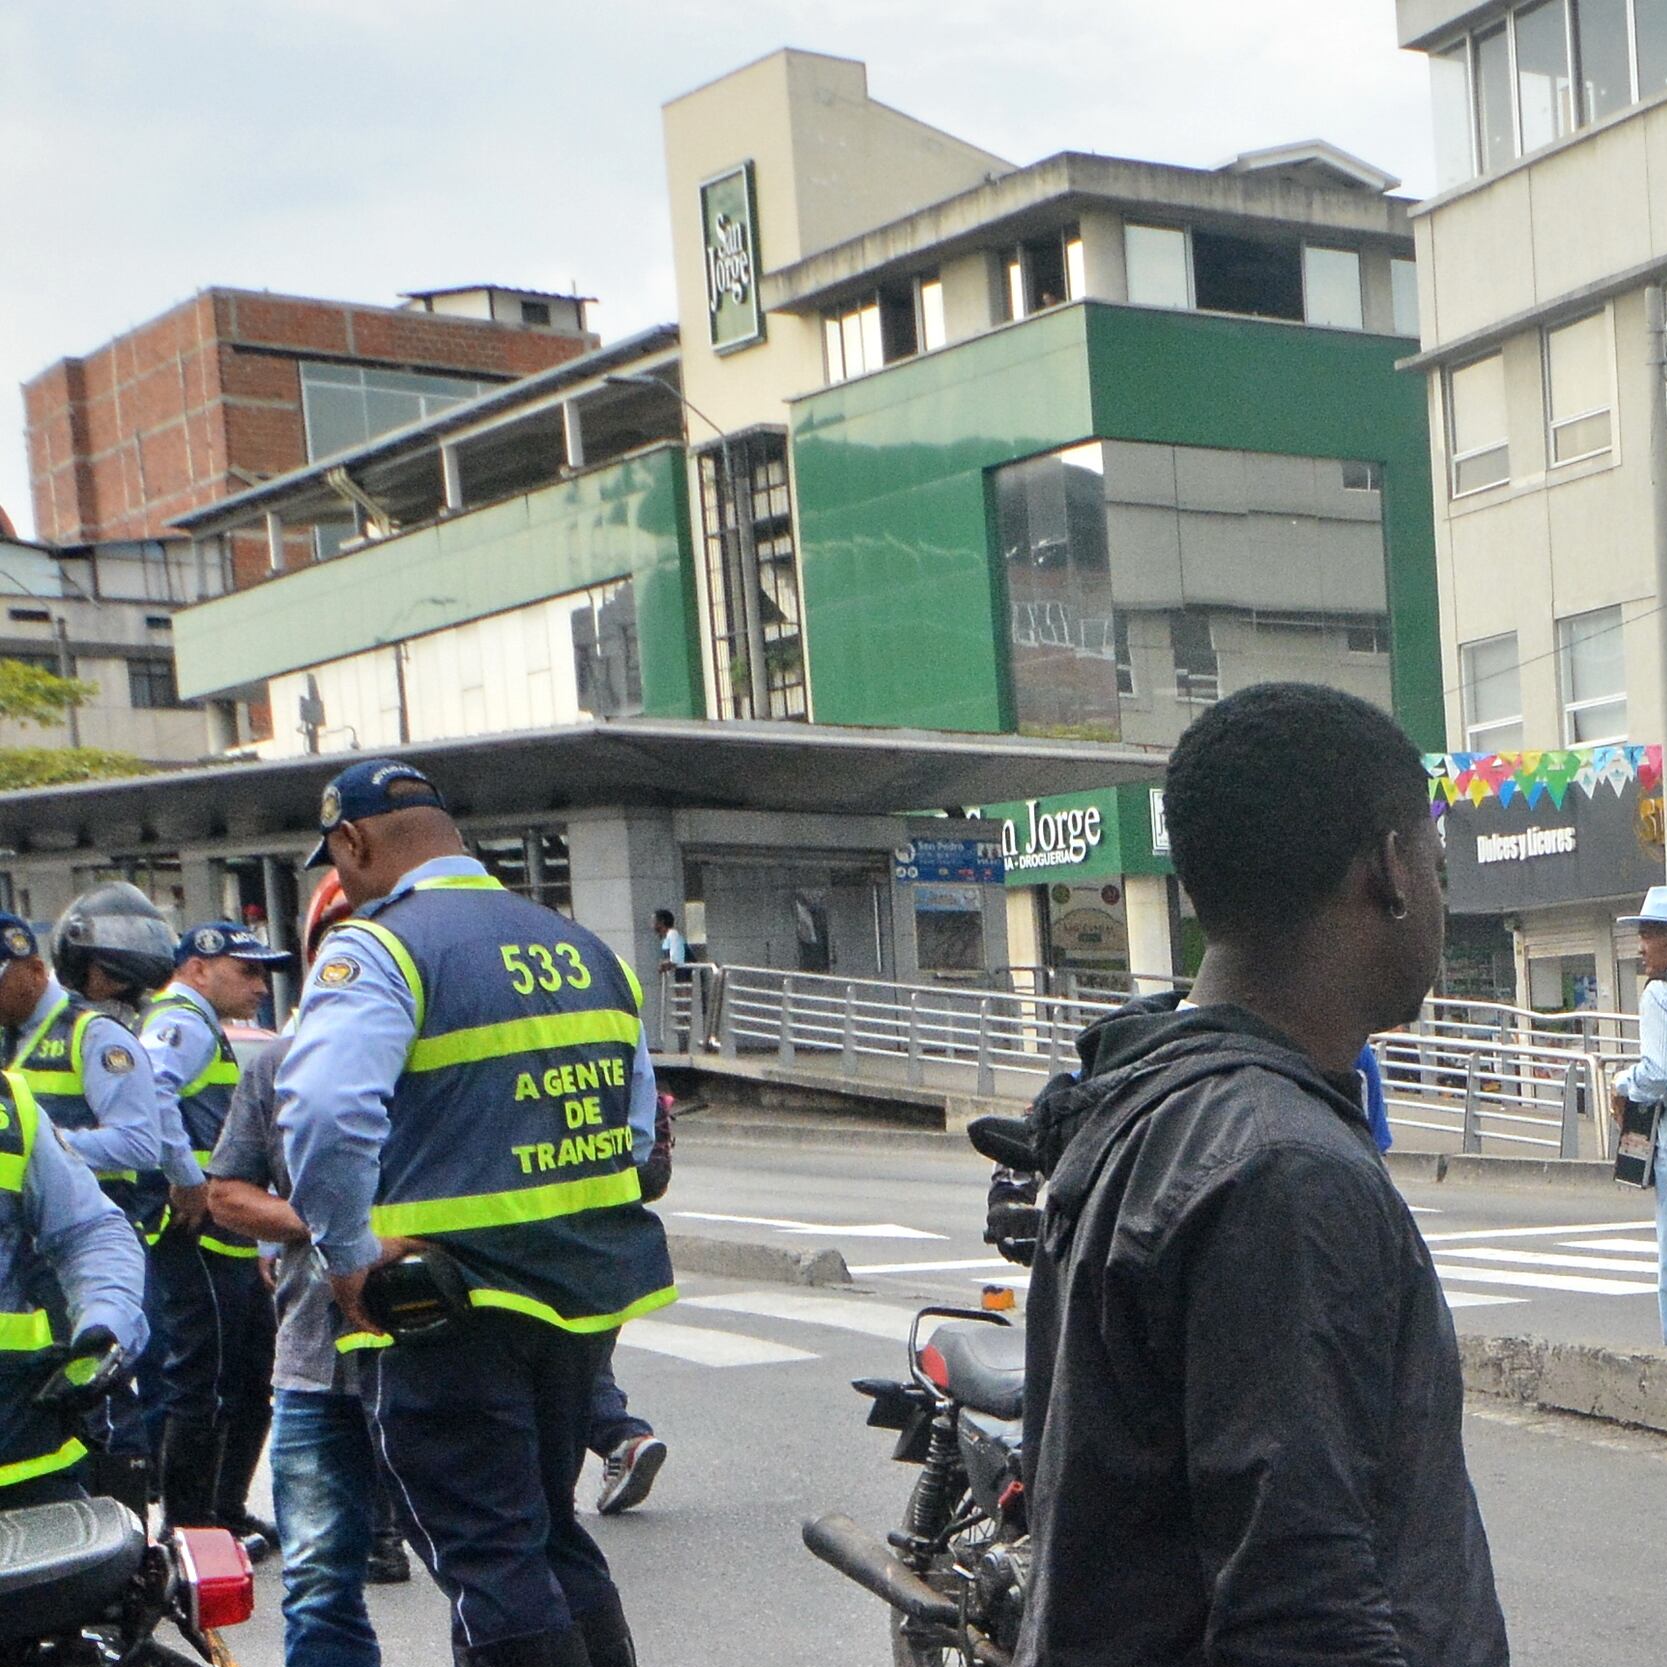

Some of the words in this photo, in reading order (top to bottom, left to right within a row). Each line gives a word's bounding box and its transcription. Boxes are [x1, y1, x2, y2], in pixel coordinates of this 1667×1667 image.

[716, 212, 742, 258] San
[708, 246, 749, 313] Jorge
[1026, 800, 1101, 863] Jorge
[1477, 834, 1519, 863] Dulces
[1527, 826, 1577, 857] Licores
[500, 942, 591, 995] 533
[514, 1058, 626, 1102] AGENTE
[565, 1097, 603, 1129] DE
[511, 1125, 633, 1174] TRANSITO
